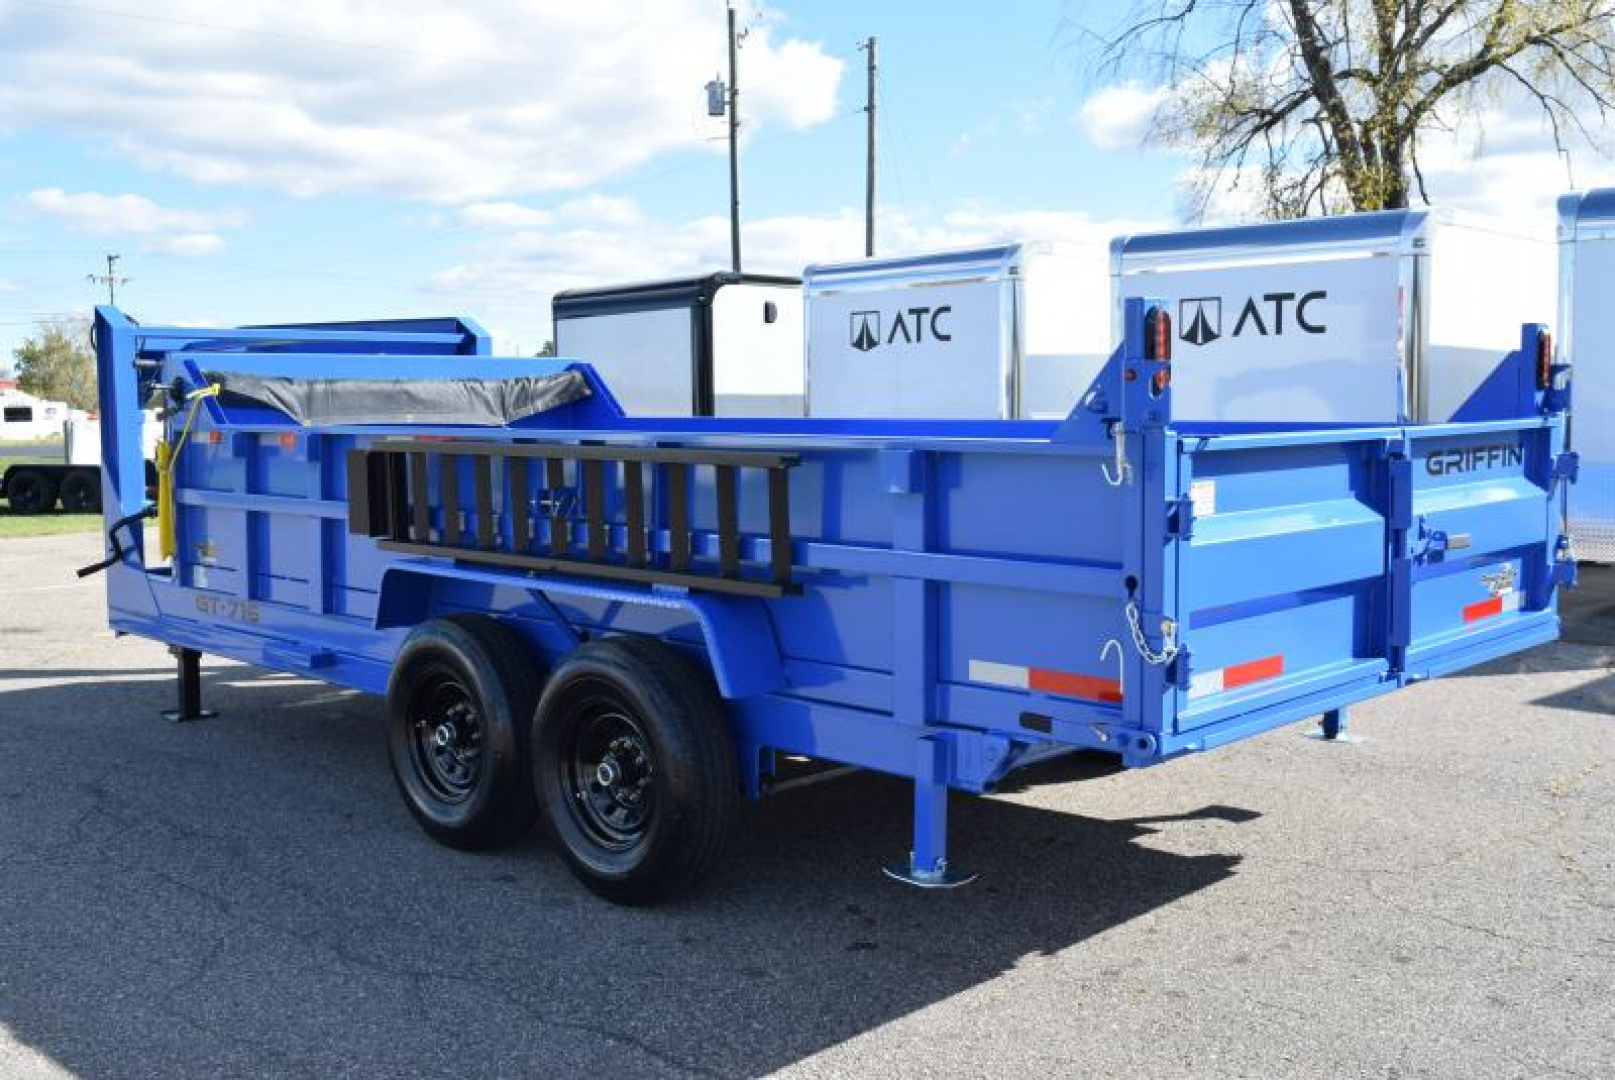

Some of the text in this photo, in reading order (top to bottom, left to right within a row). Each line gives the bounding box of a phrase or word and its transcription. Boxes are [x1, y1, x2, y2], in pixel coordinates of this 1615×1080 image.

[887, 305, 952, 343] ATC
[1232, 290, 1327, 337] ATC
[1426, 444, 1523, 475] GRIFFIN
[195, 595, 259, 622] GT-716
